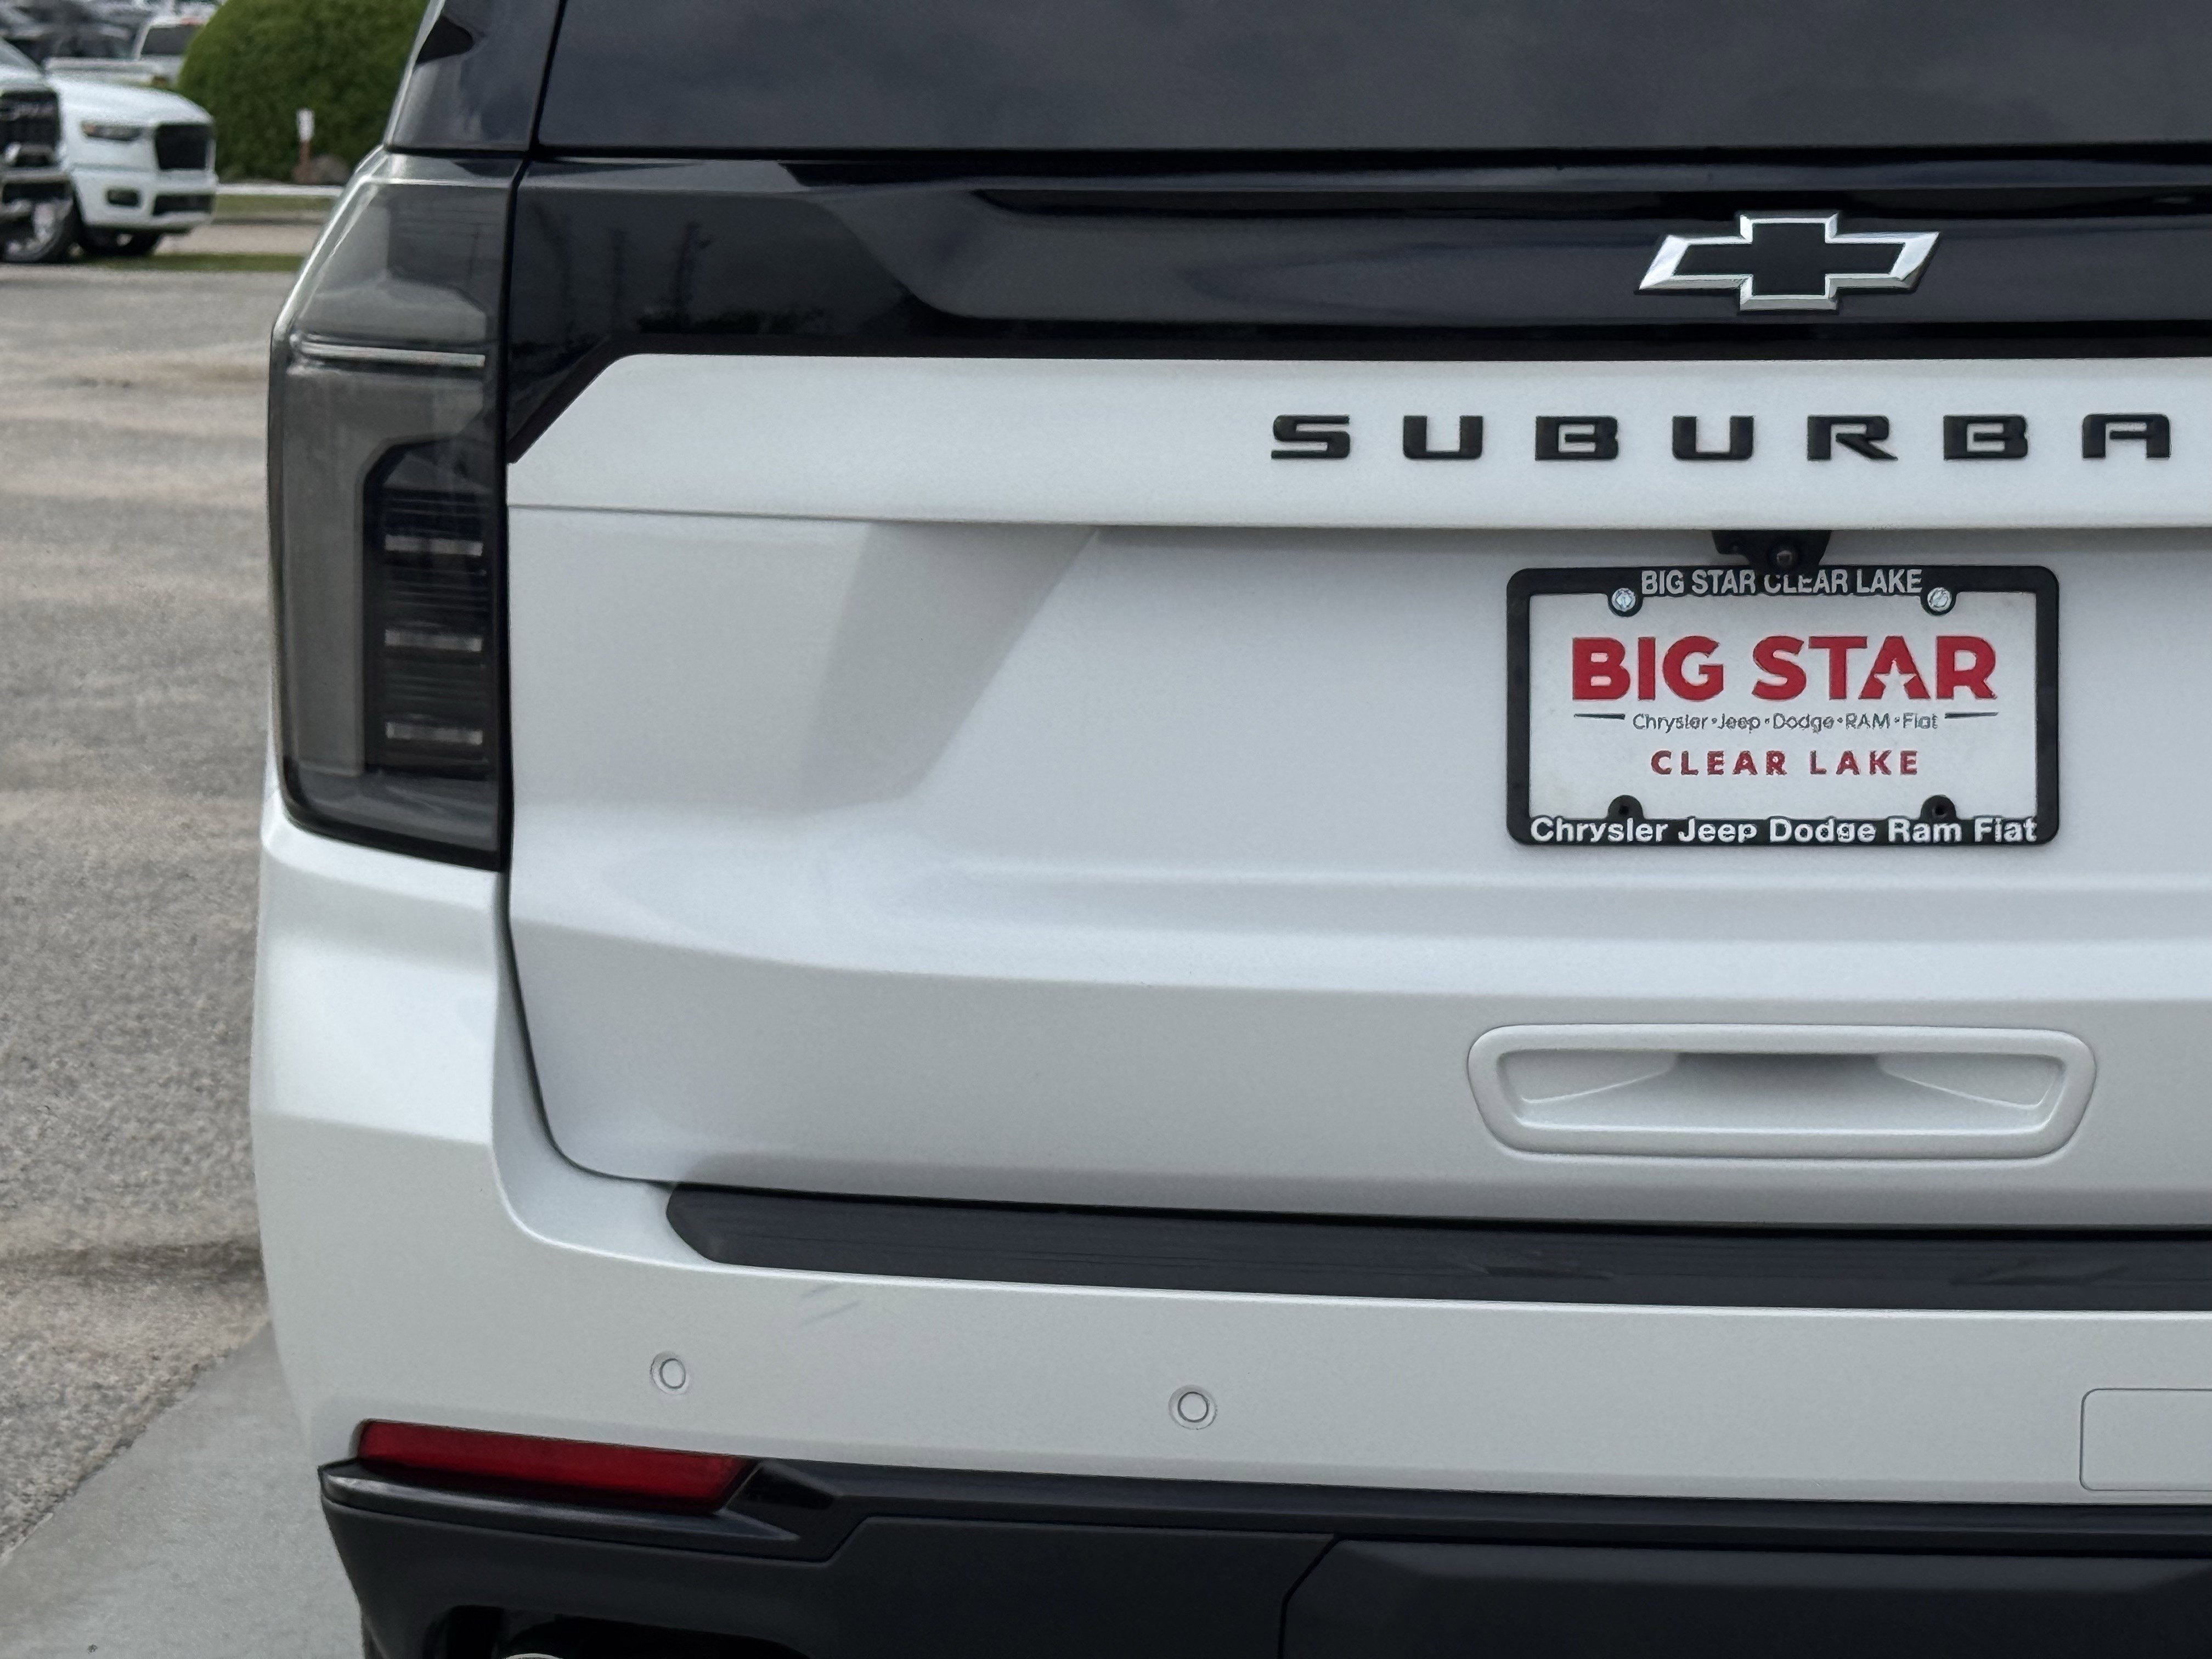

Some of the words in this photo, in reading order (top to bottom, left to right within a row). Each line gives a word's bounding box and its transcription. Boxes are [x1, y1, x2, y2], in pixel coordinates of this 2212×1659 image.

[1641, 569, 1684, 594] BIG
[1691, 569, 1755, 594] STAR
[1764, 569, 1848, 594] CLEAR
[1856, 569, 1922, 594] LAKE
[1572, 635, 1725, 702] BIG
[1751, 635, 1998, 702] STAR
[1633, 713, 1708, 733] Chrysler
[1717, 713, 1761, 733] Jeep
[1773, 713, 1833, 733] Dodge
[1846, 713, 1891, 729] RAM
[1903, 713, 1938, 729] Fiat
[1651, 750, 1787, 776] CLEAR
[1810, 749, 1917, 776] LAKE
[1531, 817, 1668, 843] Chrysler
[1678, 817, 1757, 843] Jeep
[1769, 818, 1876, 843] Dodge
[1888, 817, 1962, 843] Ram
[1974, 817, 2038, 842] Fiat
